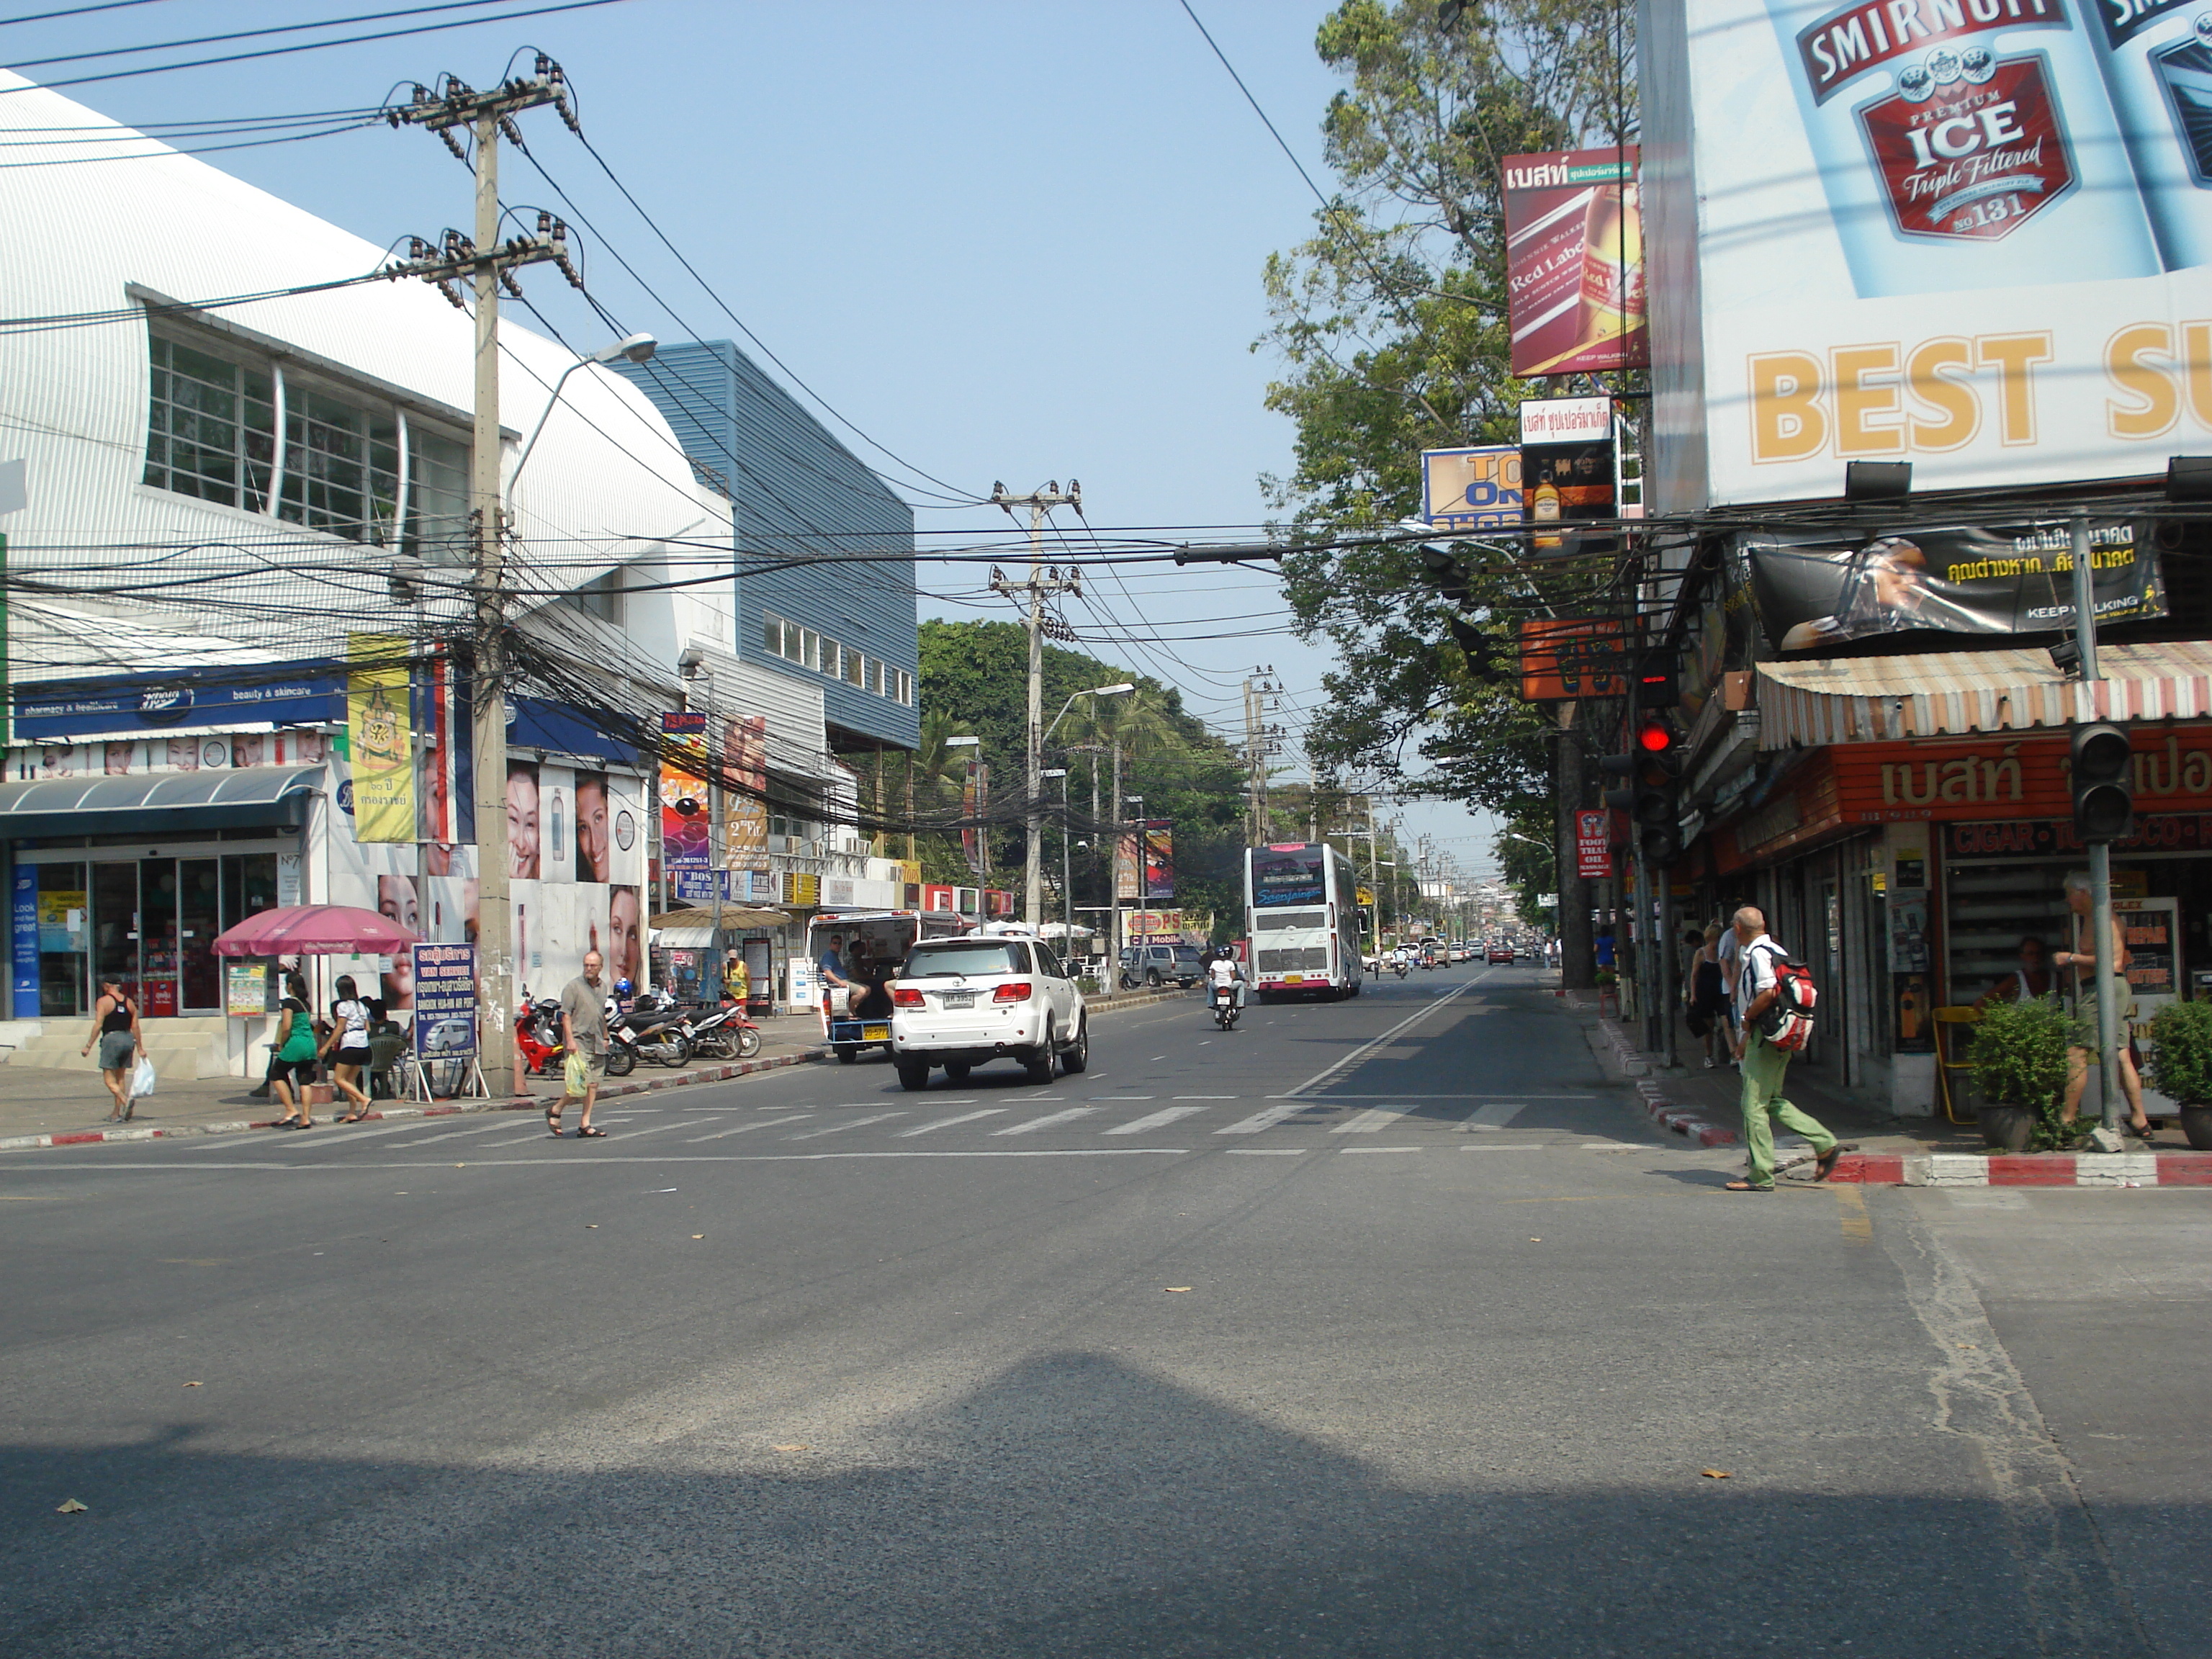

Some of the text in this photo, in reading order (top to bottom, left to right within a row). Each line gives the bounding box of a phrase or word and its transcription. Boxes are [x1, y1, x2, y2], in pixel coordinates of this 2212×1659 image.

[1910, 89, 2002, 126] PREMIUM
[1905, 99, 2024, 170] ICE
[1506, 155, 1570, 189] เบสท์
[1902, 135, 2044, 203] Triple Filtered
[1972, 193, 2027, 228] 131
[1510, 264, 1545, 294] Red
[1746, 331, 2055, 465] BEST
[1523, 407, 1547, 433] เบสท์
[2028, 605, 2069, 619] KEEP
[233, 685, 311, 700] beauty & skincare
[1881, 741, 2024, 806] เบสท์
[1954, 819, 2035, 853] CIGAR
[14, 903, 35, 913] Look
[14, 922, 37, 934] great
[1152, 935, 1182, 944] Mobile
[421, 965, 470, 978] VAN SERVICE
